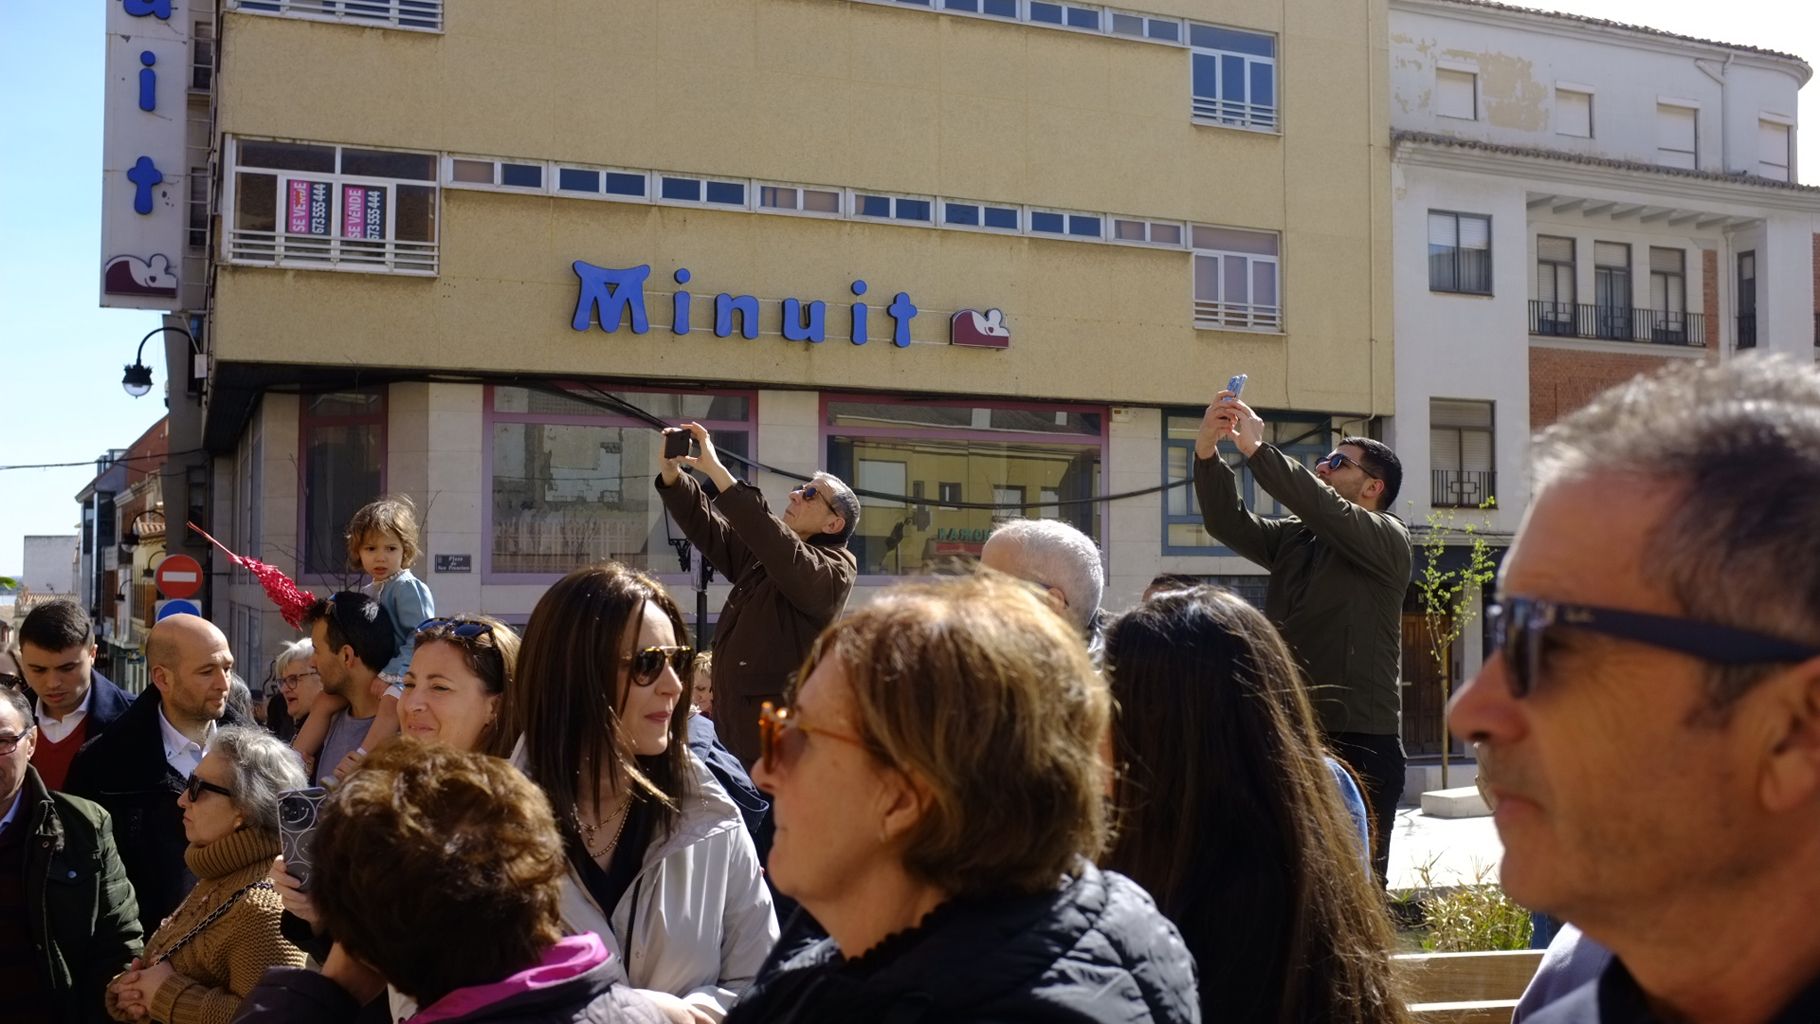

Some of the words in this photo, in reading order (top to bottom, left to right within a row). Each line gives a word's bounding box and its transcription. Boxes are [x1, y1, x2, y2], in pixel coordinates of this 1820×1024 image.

[313, 184, 326, 201] 444
[367, 191, 381, 208] 444
[312, 202, 326, 218] 555
[348, 189, 362, 224] VENDE
[367, 209, 381, 225] 555
[292, 219, 306, 232] SE
[311, 218, 326, 234] 673
[348, 226, 361, 239] SE
[571, 260, 918, 348] Minuit
